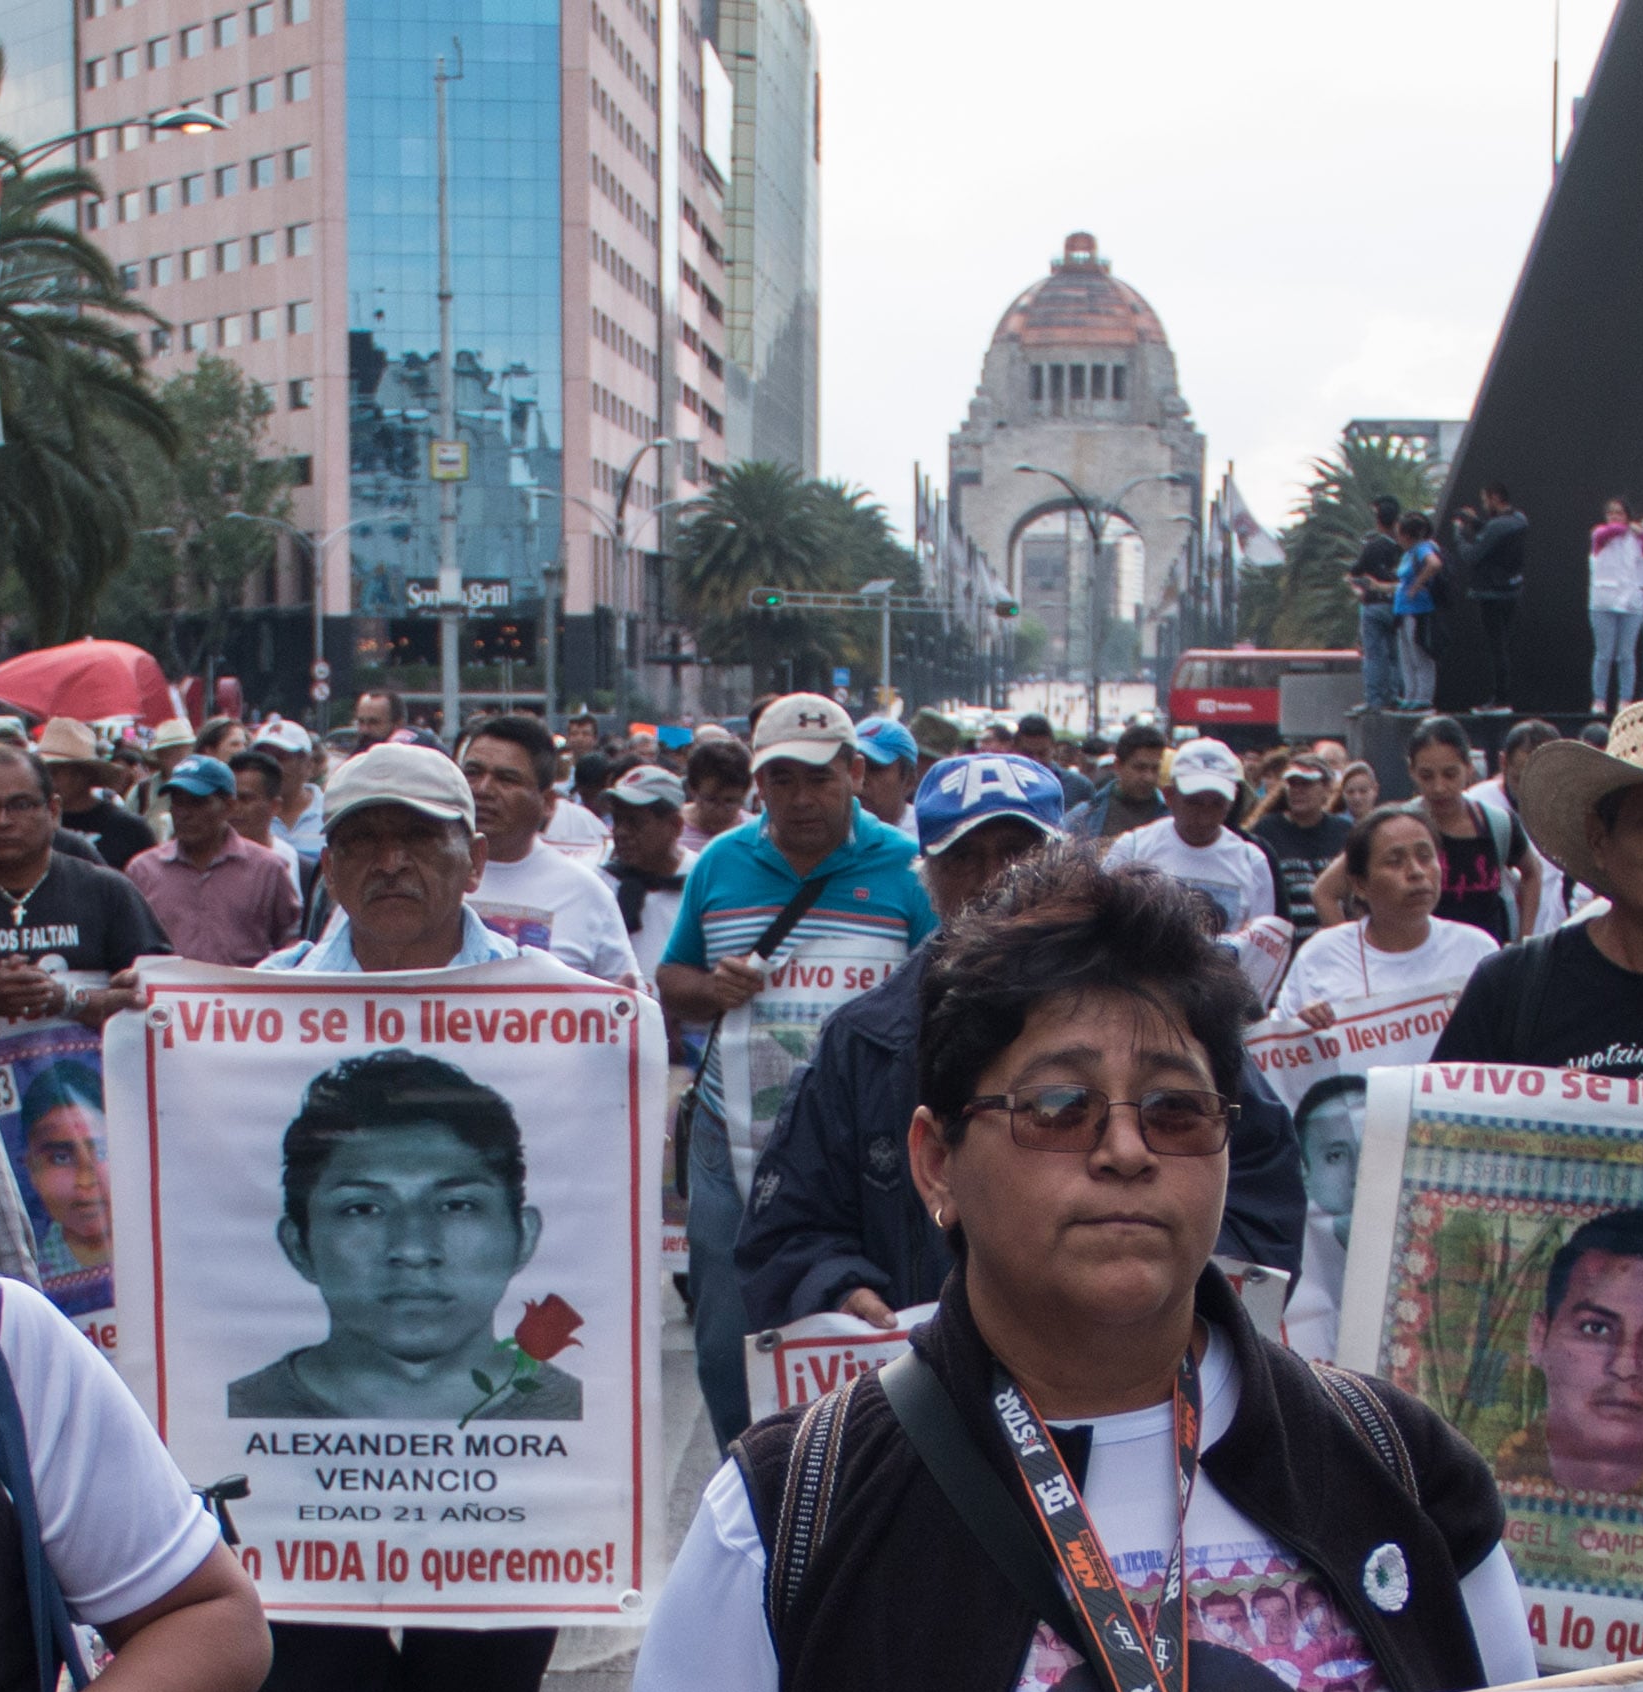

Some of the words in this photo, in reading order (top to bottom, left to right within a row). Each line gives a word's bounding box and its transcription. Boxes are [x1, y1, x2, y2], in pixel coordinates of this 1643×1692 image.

[22, 924, 79, 949] FALTAN
[843, 964, 875, 990] se
[162, 1000, 283, 1050] ¡Vivo
[299, 1006, 348, 1044] se
[364, 1001, 405, 1044] lo
[421, 999, 621, 1045] llevaron!
[1285, 1044, 1313, 1069] se
[1313, 1034, 1341, 1060] lo
[1561, 1069, 1612, 1104] se
[245, 1432, 454, 1458] ALEXANDER
[463, 1433, 569, 1458] MORA
[315, 1467, 498, 1493] VENANCIO
[297, 1504, 384, 1522] EDAD
[393, 1504, 428, 1522] 21
[440, 1500, 527, 1523] AÑOS
[275, 1539, 366, 1584] VIDA
[377, 1541, 409, 1584] lo
[420, 1541, 615, 1591] queremos!
[1559, 1605, 1596, 1652] lo
